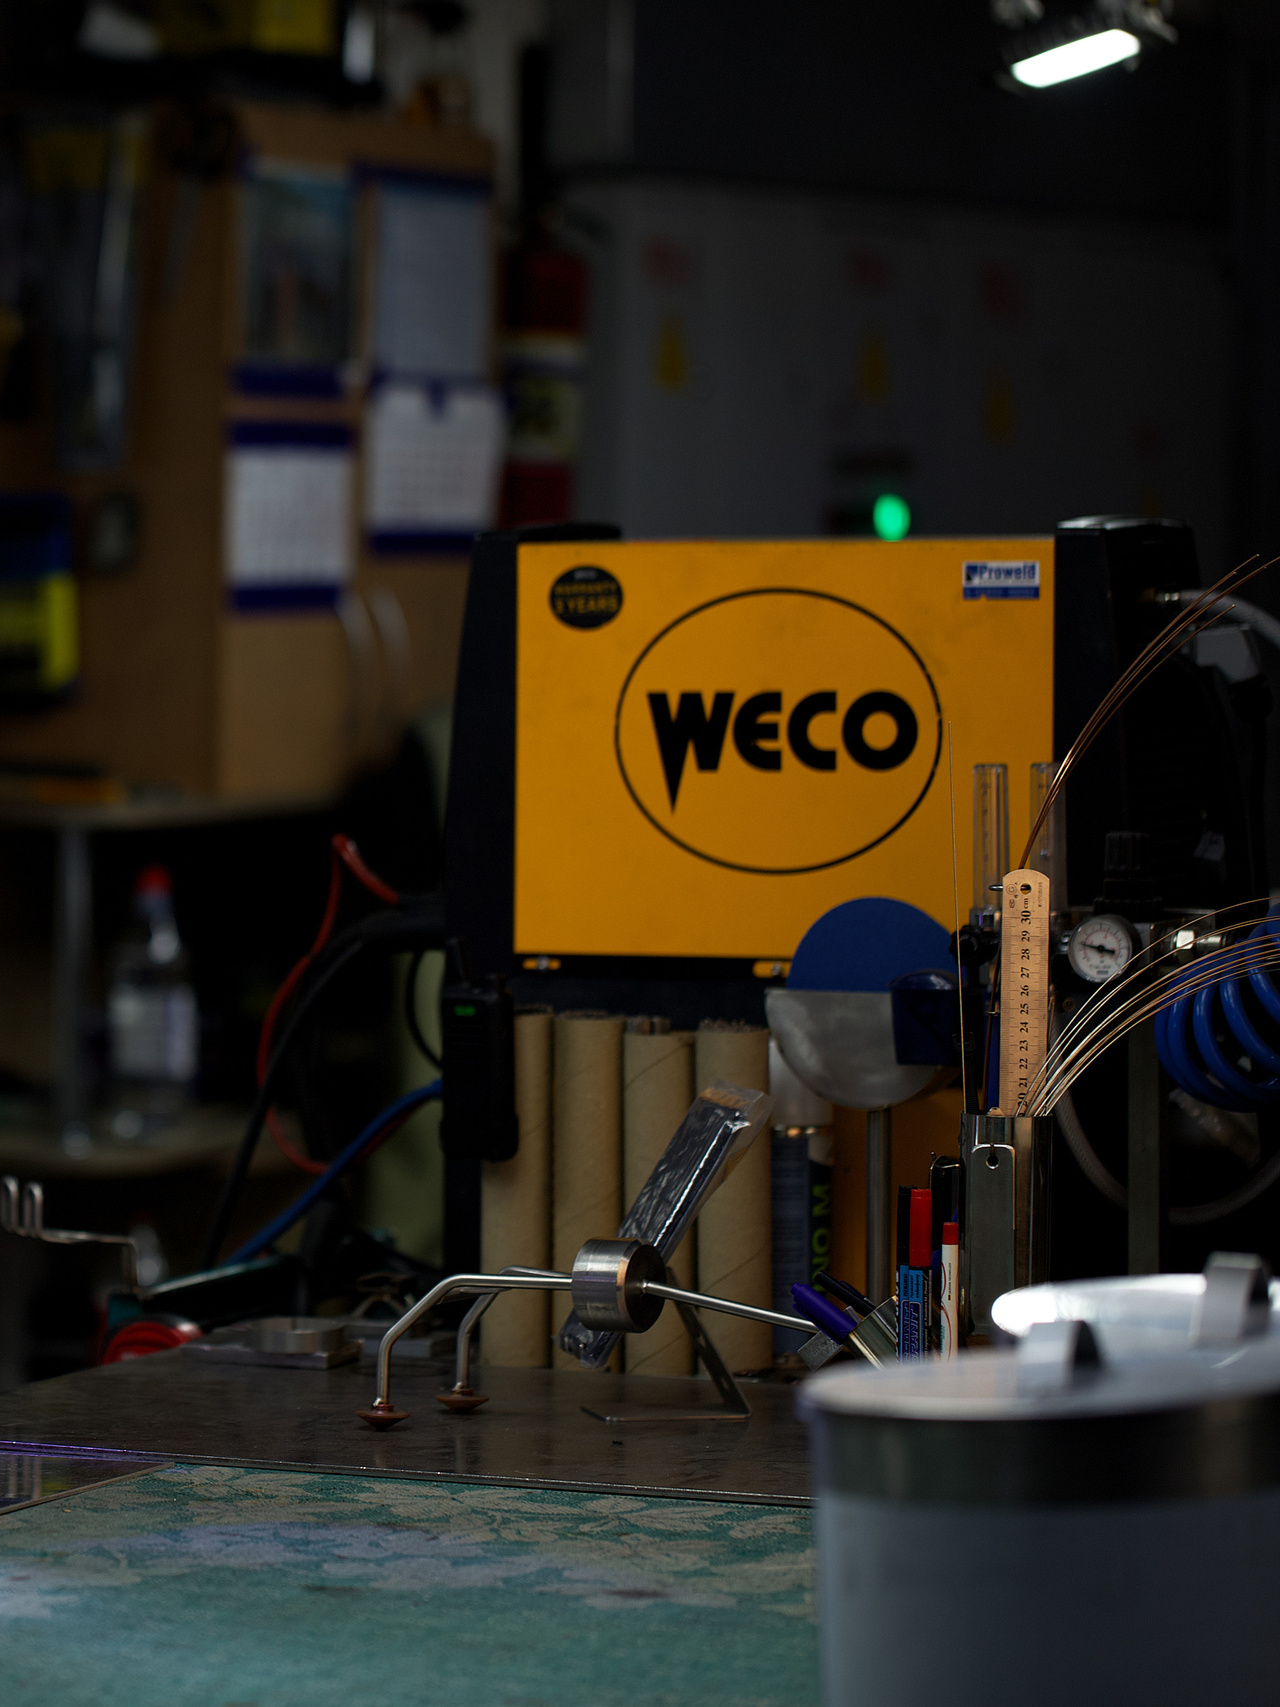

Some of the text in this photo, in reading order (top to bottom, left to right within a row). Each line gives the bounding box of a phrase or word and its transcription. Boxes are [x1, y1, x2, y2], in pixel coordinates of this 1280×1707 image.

[978, 564, 1036, 580] Proweld
[647, 690, 920, 816] WECO
[1024, 898, 1029, 909] cm
[1021, 910, 1031, 925] 30
[1021, 930, 1030, 942] 29
[1021, 948, 1030, 960] 28
[1021, 967, 1030, 979] 27
[1020, 985, 1029, 997] 26
[1020, 1003, 1029, 1015] 25
[1020, 1021, 1029, 1033] 24
[1020, 1040, 1029, 1052] 23
[1019, 1058, 1028, 1070] 22
[1019, 1077, 1028, 1088] 21
